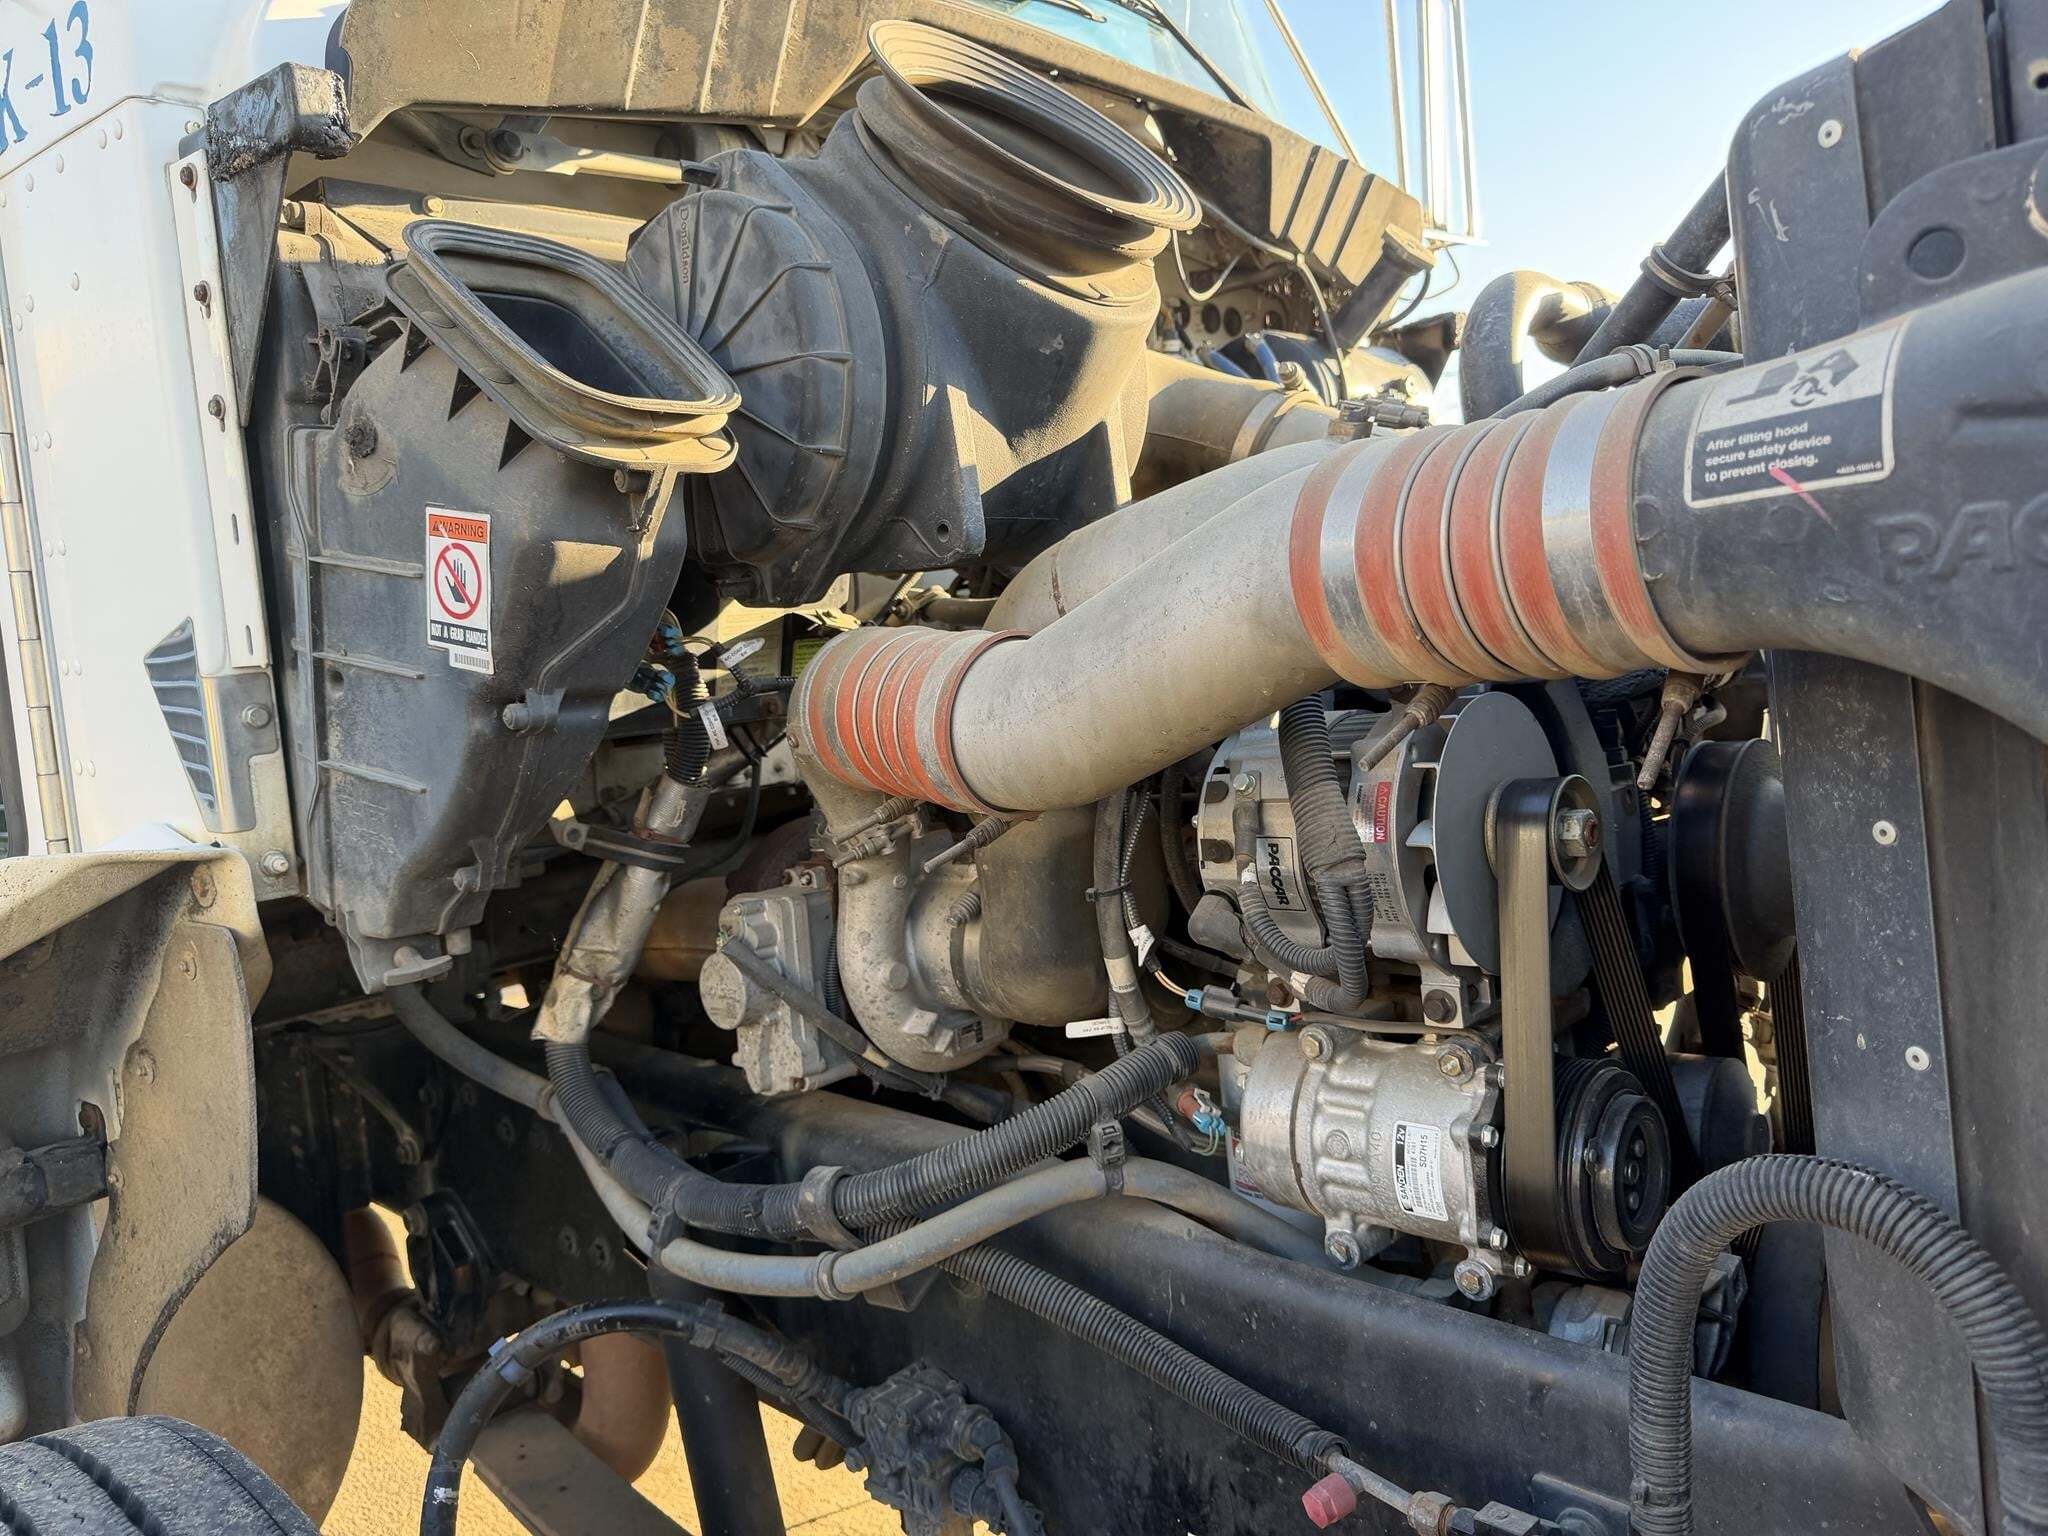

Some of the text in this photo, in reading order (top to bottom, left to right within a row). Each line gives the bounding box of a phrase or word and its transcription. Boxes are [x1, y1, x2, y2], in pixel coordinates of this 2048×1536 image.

[680, 207, 691, 284] Donaldson
[1705, 434, 1832, 466] secure safety device
[1706, 421, 1808, 452] After tilting hood
[1704, 471, 1718, 482] to
[1719, 462, 1766, 482] prevent
[441, 521, 484, 538] WARNING
[1376, 796, 1388, 840] CAUTION
[1268, 843, 1290, 905] PACCAR
[1396, 1165, 1409, 1200] SANDEN
